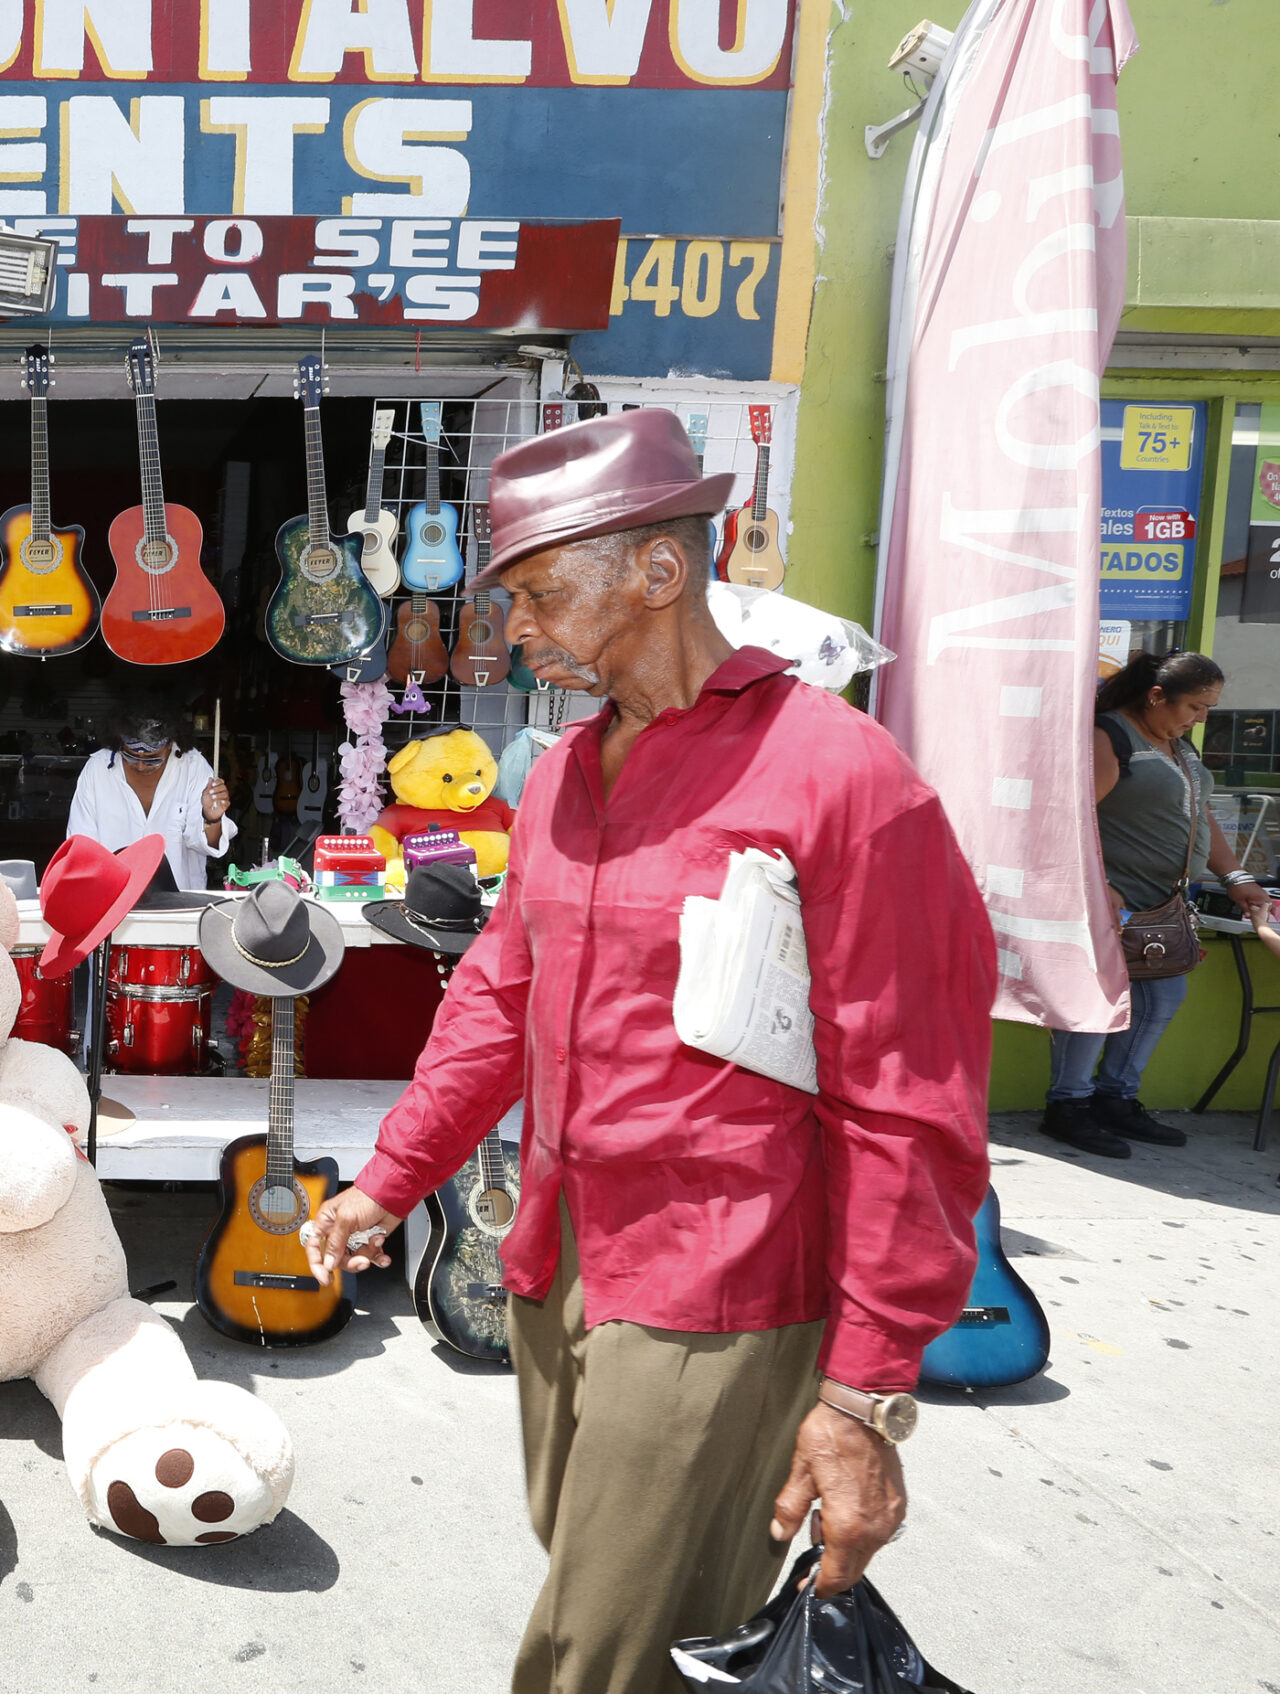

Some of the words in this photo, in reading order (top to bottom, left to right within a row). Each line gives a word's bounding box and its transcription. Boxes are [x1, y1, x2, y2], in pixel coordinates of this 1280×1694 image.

[127, 218, 264, 265] TO
[314, 220, 520, 270] SEE
[1139, 412, 1173, 422] Including
[1138, 431, 1181, 454] 75+
[1136, 455, 1169, 463] Countries
[1144, 521, 1186, 539] 1GB
